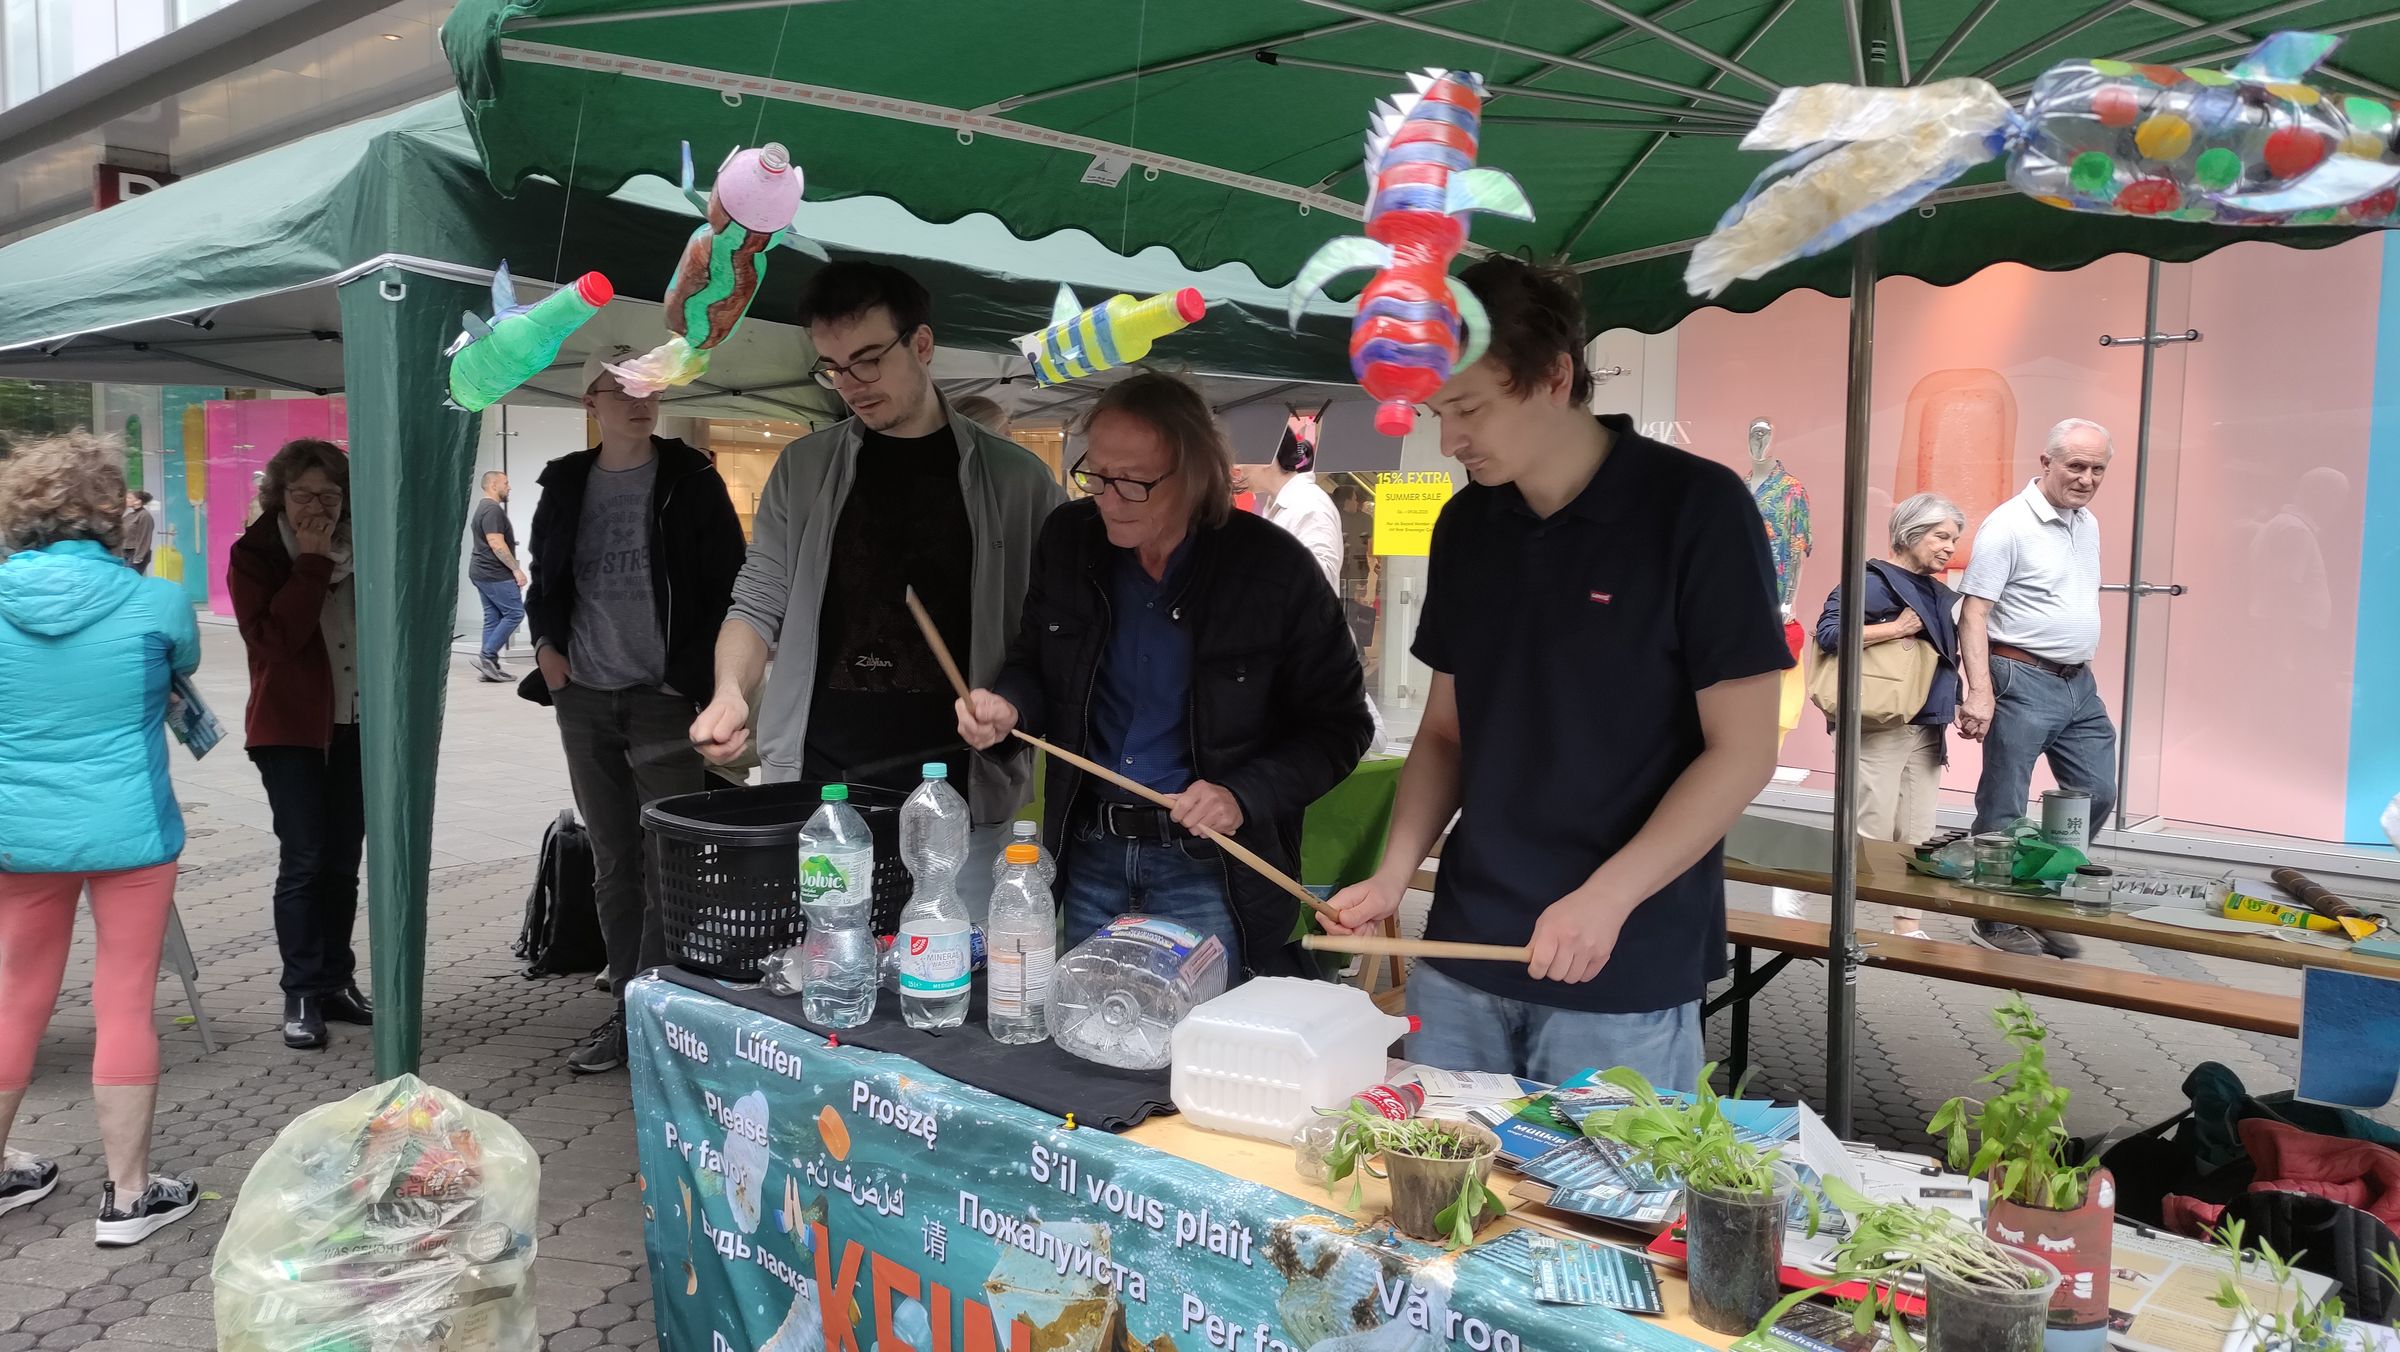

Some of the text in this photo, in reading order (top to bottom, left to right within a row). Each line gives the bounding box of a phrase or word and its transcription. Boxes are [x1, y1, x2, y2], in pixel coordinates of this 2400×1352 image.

[1376, 471, 1452, 484] 15% EXTRA
[1385, 493, 1441, 501] SUMMER SALE
[665, 1021, 709, 1064] Bitte
[735, 1027, 802, 1080] Lütfen
[705, 1091, 768, 1146] Please
[852, 1080, 938, 1150] Proszę
[665, 1122, 748, 1186] Pr favor
[921, 1215, 948, 1263] 请
[959, 1190, 1147, 1303] Пожалуйста
[1087, 1174, 1165, 1229] vous
[1175, 1208, 1253, 1266] plaît
[757, 1244, 810, 1300] ласка
[1182, 1292, 1244, 1352] Per
[1374, 1270, 1429, 1332] Vă
